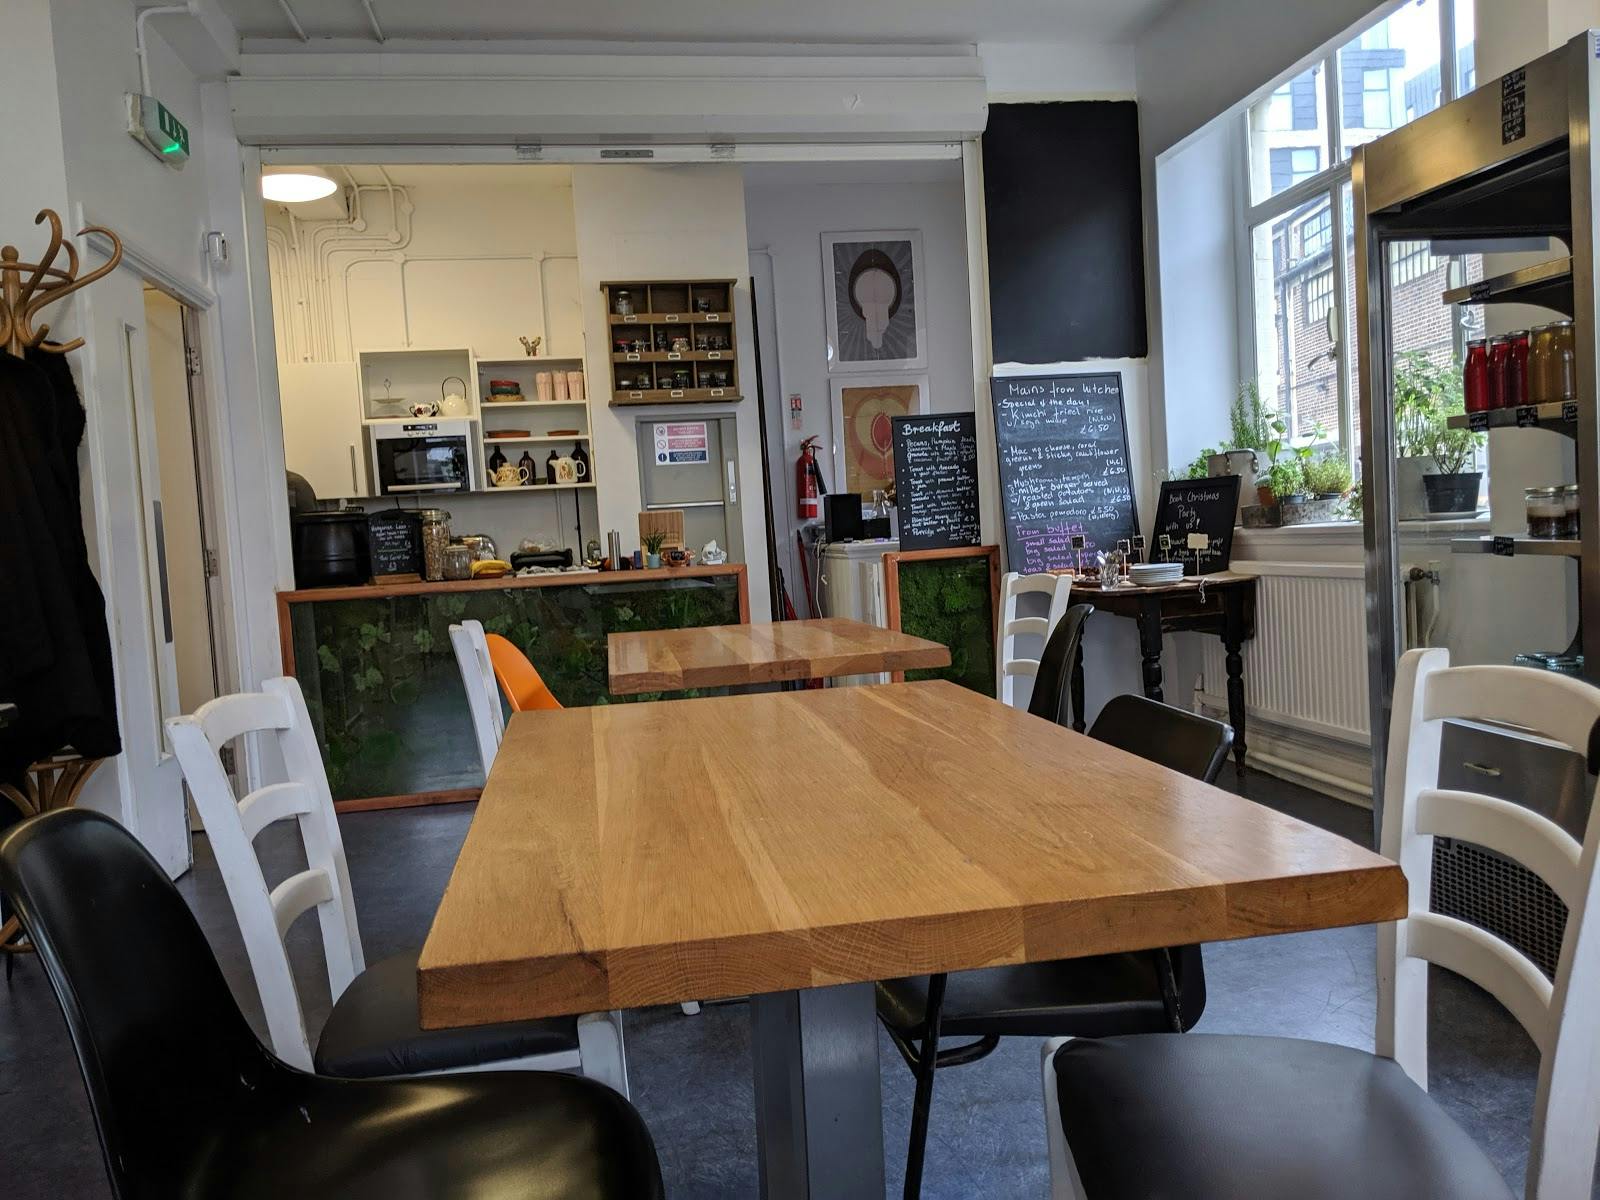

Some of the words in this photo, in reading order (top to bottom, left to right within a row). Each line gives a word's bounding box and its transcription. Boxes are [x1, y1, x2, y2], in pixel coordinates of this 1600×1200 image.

[1009, 383, 1045, 395] Mains
[1049, 381, 1075, 398] from
[1010, 409, 1046, 420] Kimchi
[1054, 408, 1081, 420] fried
[902, 420, 961, 438] Breakfast
[1010, 446, 1028, 456] Mac
[1187, 491, 1220, 503] Christmas
[1178, 504, 1196, 524] Party
[1046, 521, 1084, 536] buffet
[1048, 536, 1071, 544] salad
